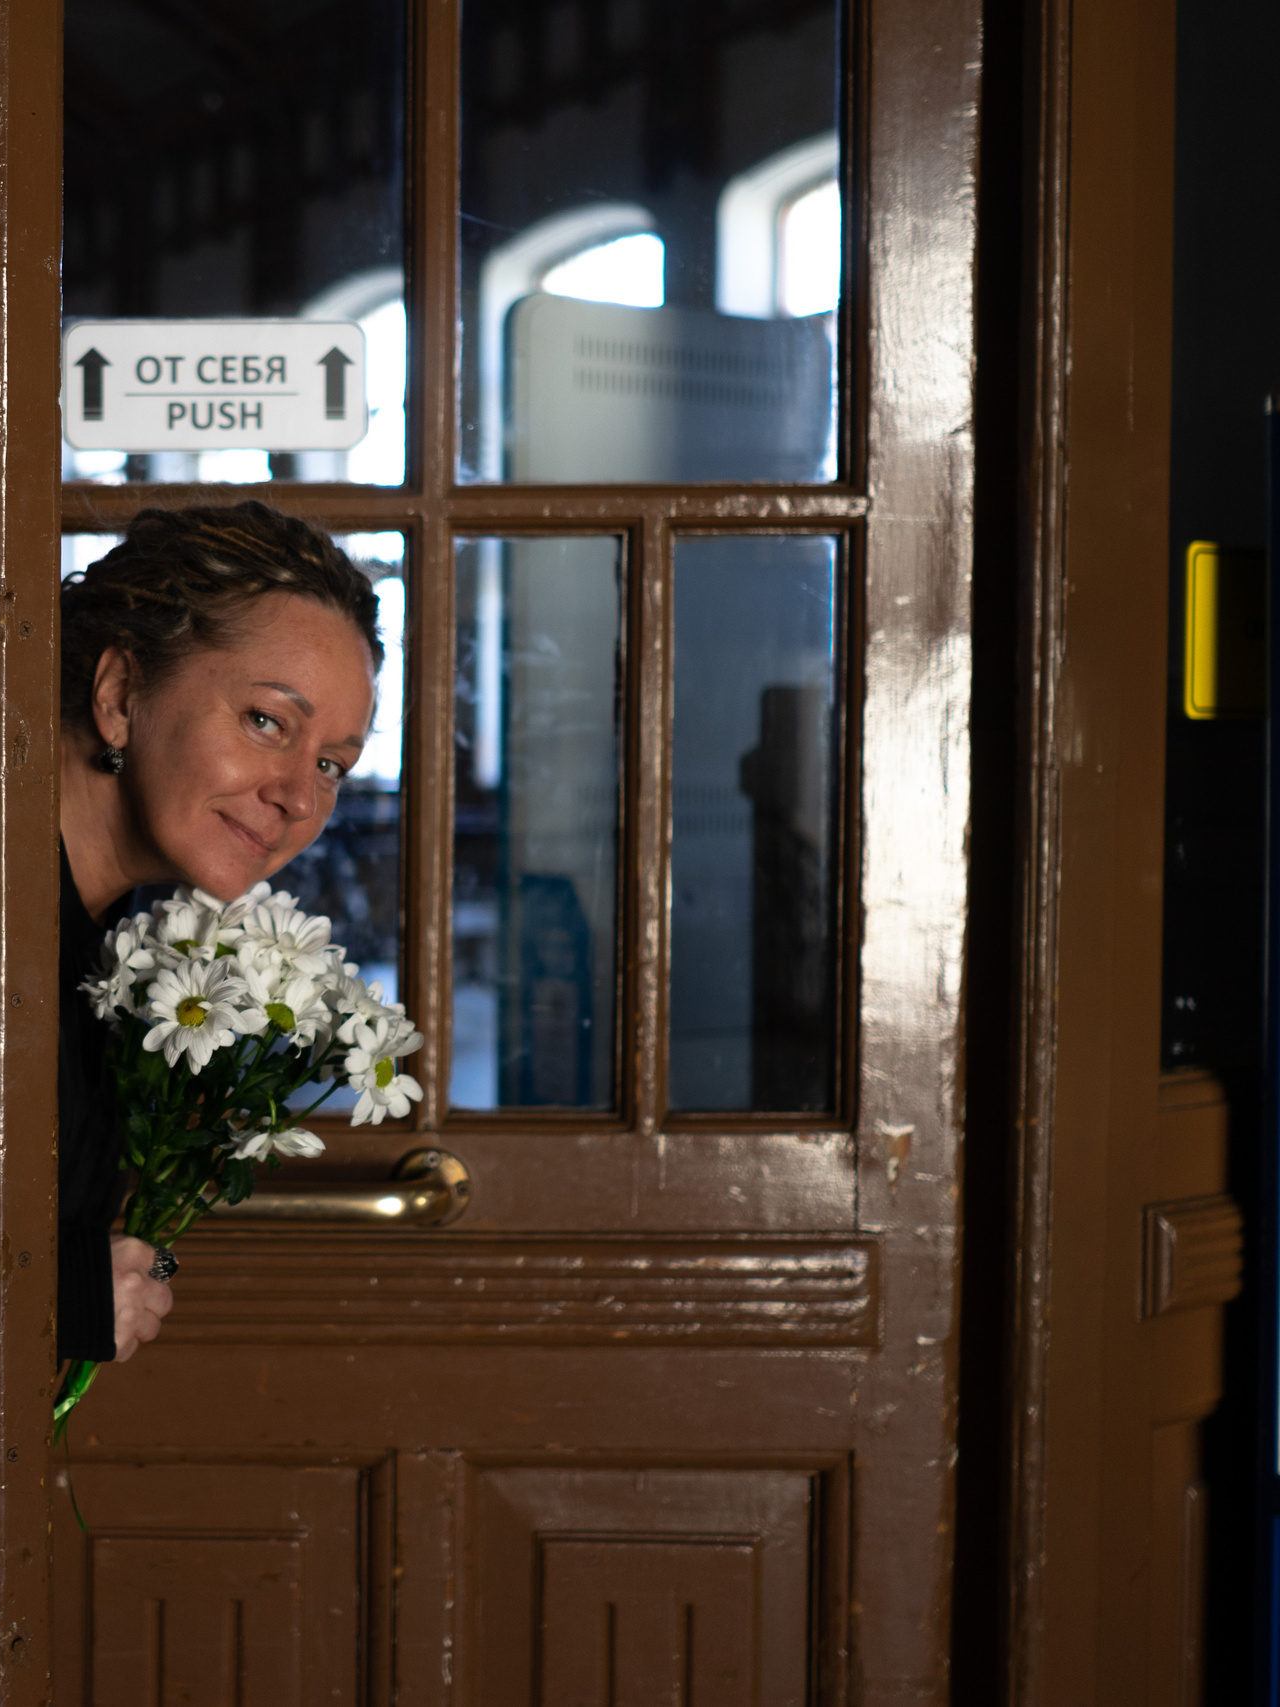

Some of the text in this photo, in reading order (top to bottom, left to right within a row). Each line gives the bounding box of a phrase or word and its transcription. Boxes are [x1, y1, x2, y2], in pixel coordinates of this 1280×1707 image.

[136, 356, 287, 384] ОТ СЕБЯ
[168, 402, 263, 430] PUSH
